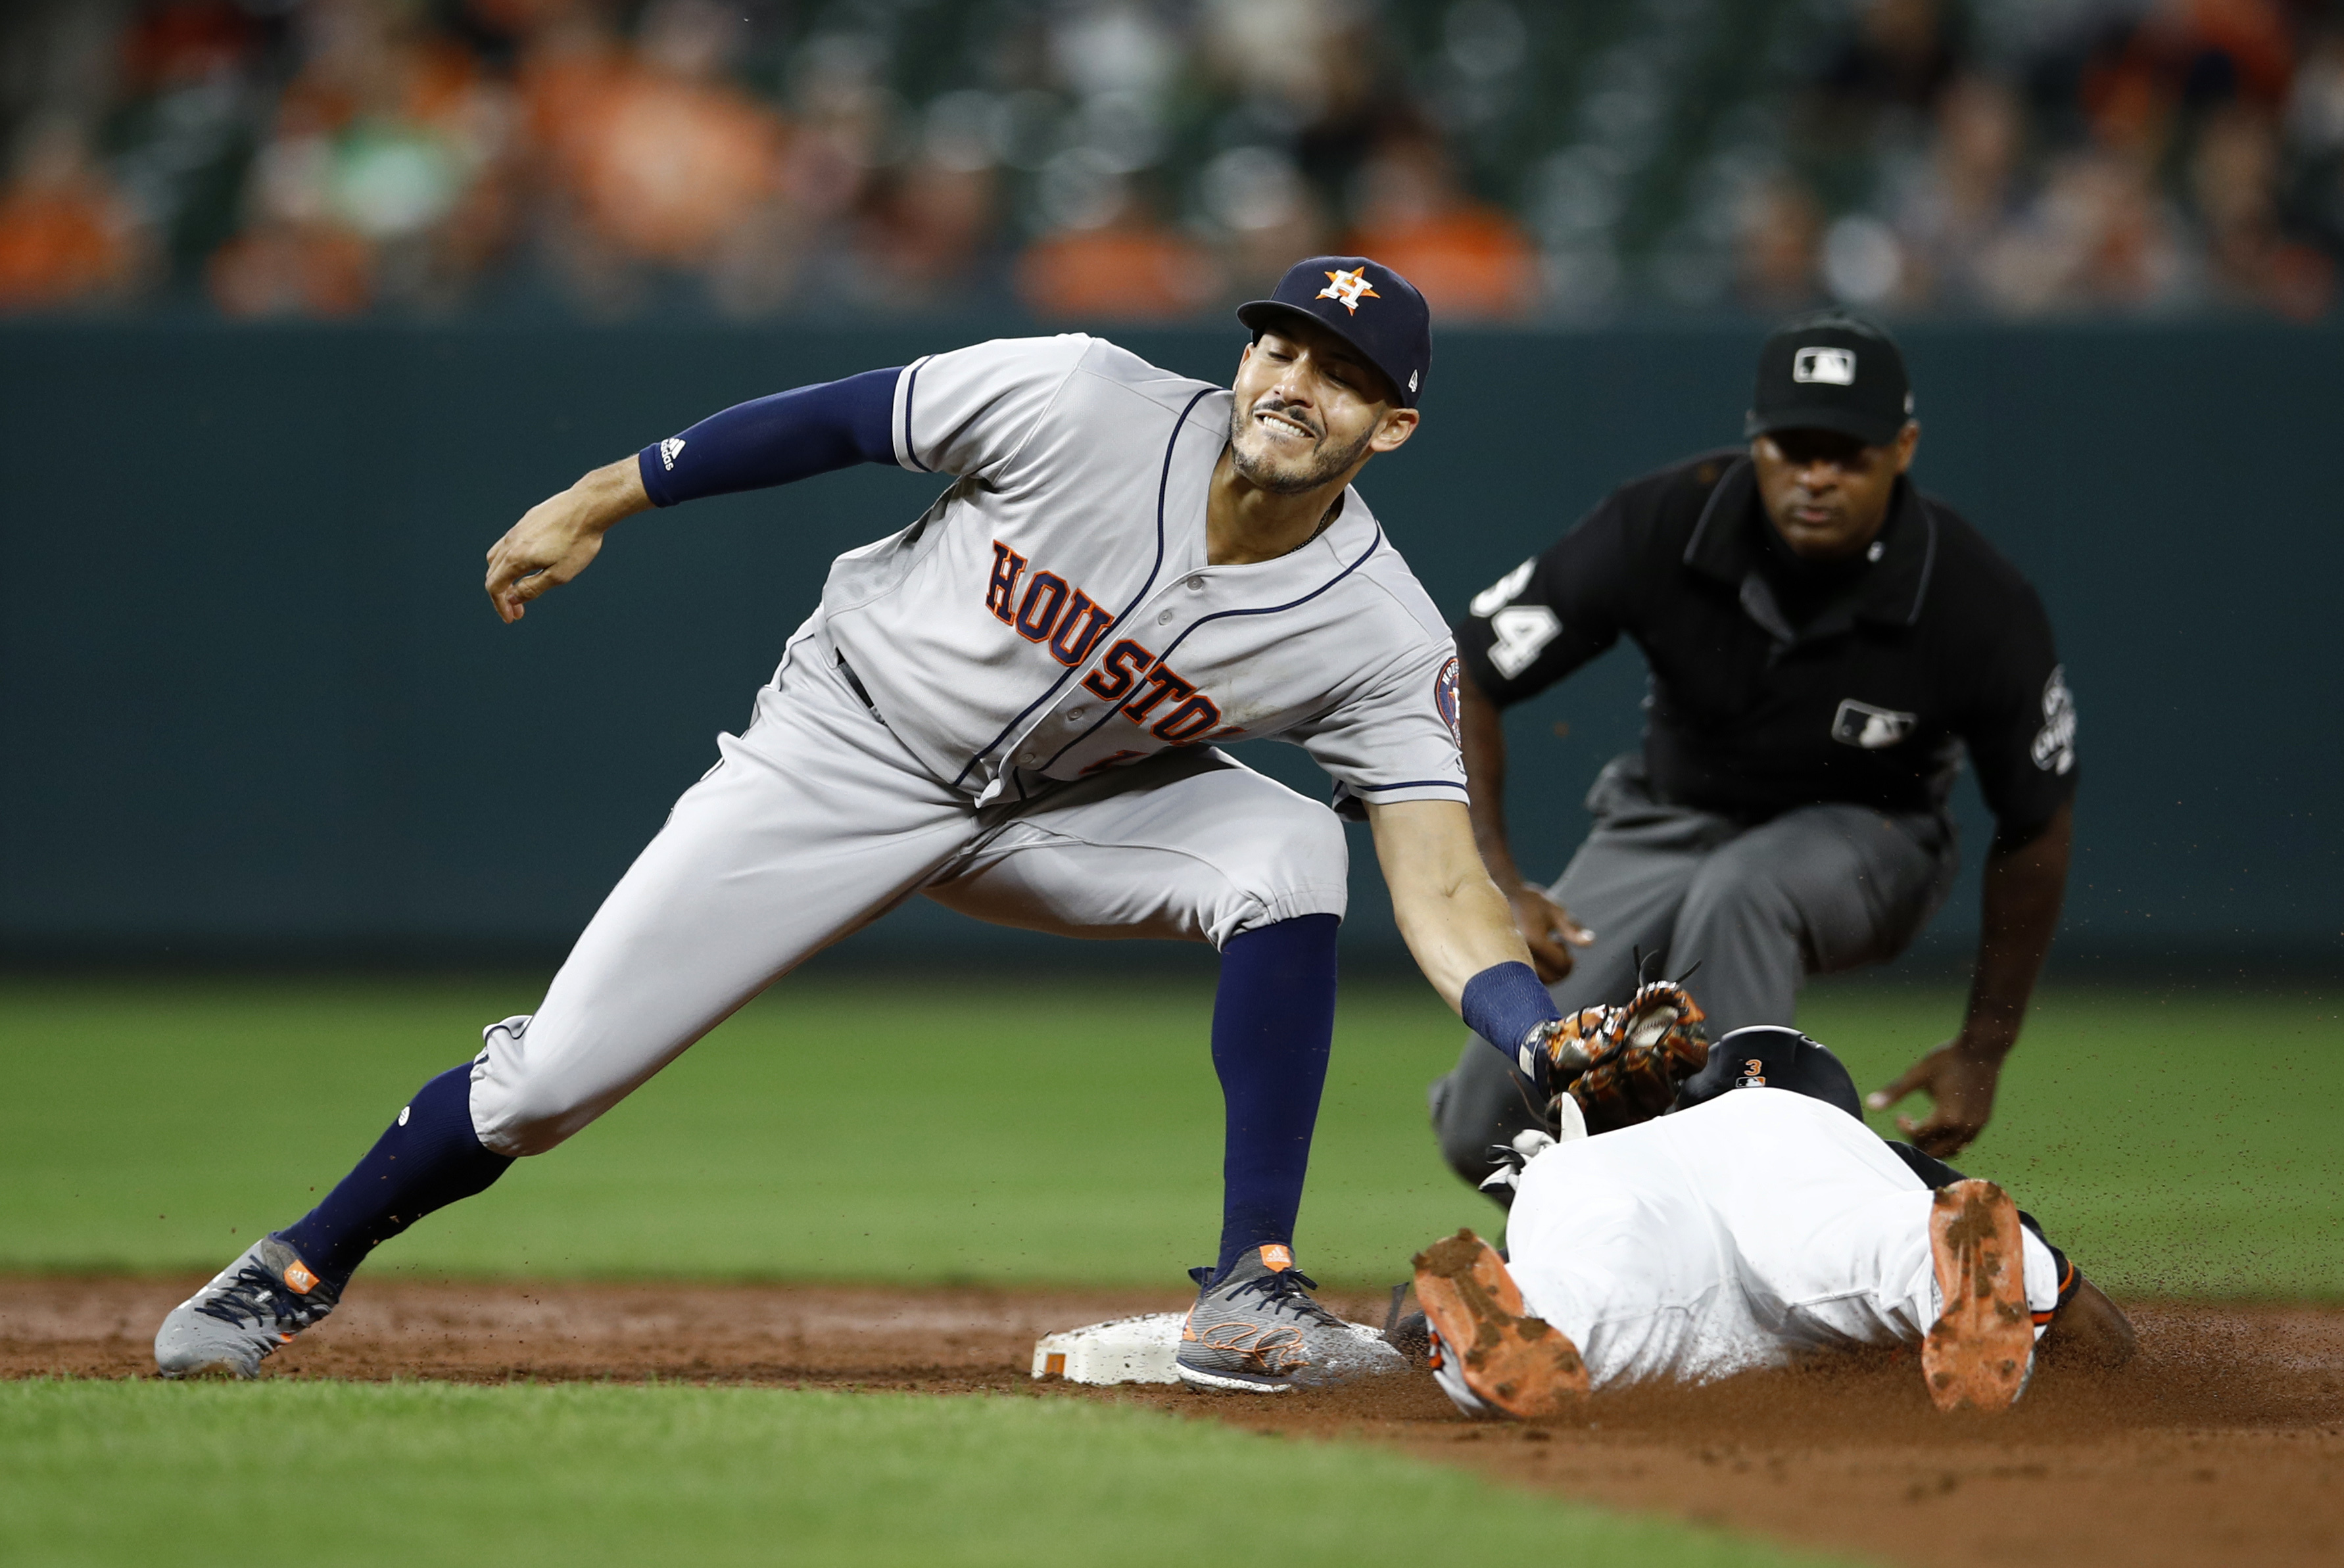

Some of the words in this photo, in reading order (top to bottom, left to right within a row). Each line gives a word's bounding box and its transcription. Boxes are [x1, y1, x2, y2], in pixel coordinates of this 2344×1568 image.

[1320, 269, 1374, 310] H
[986, 539, 1247, 747] HOUSTO
[1744, 1058, 1763, 1076] 3
